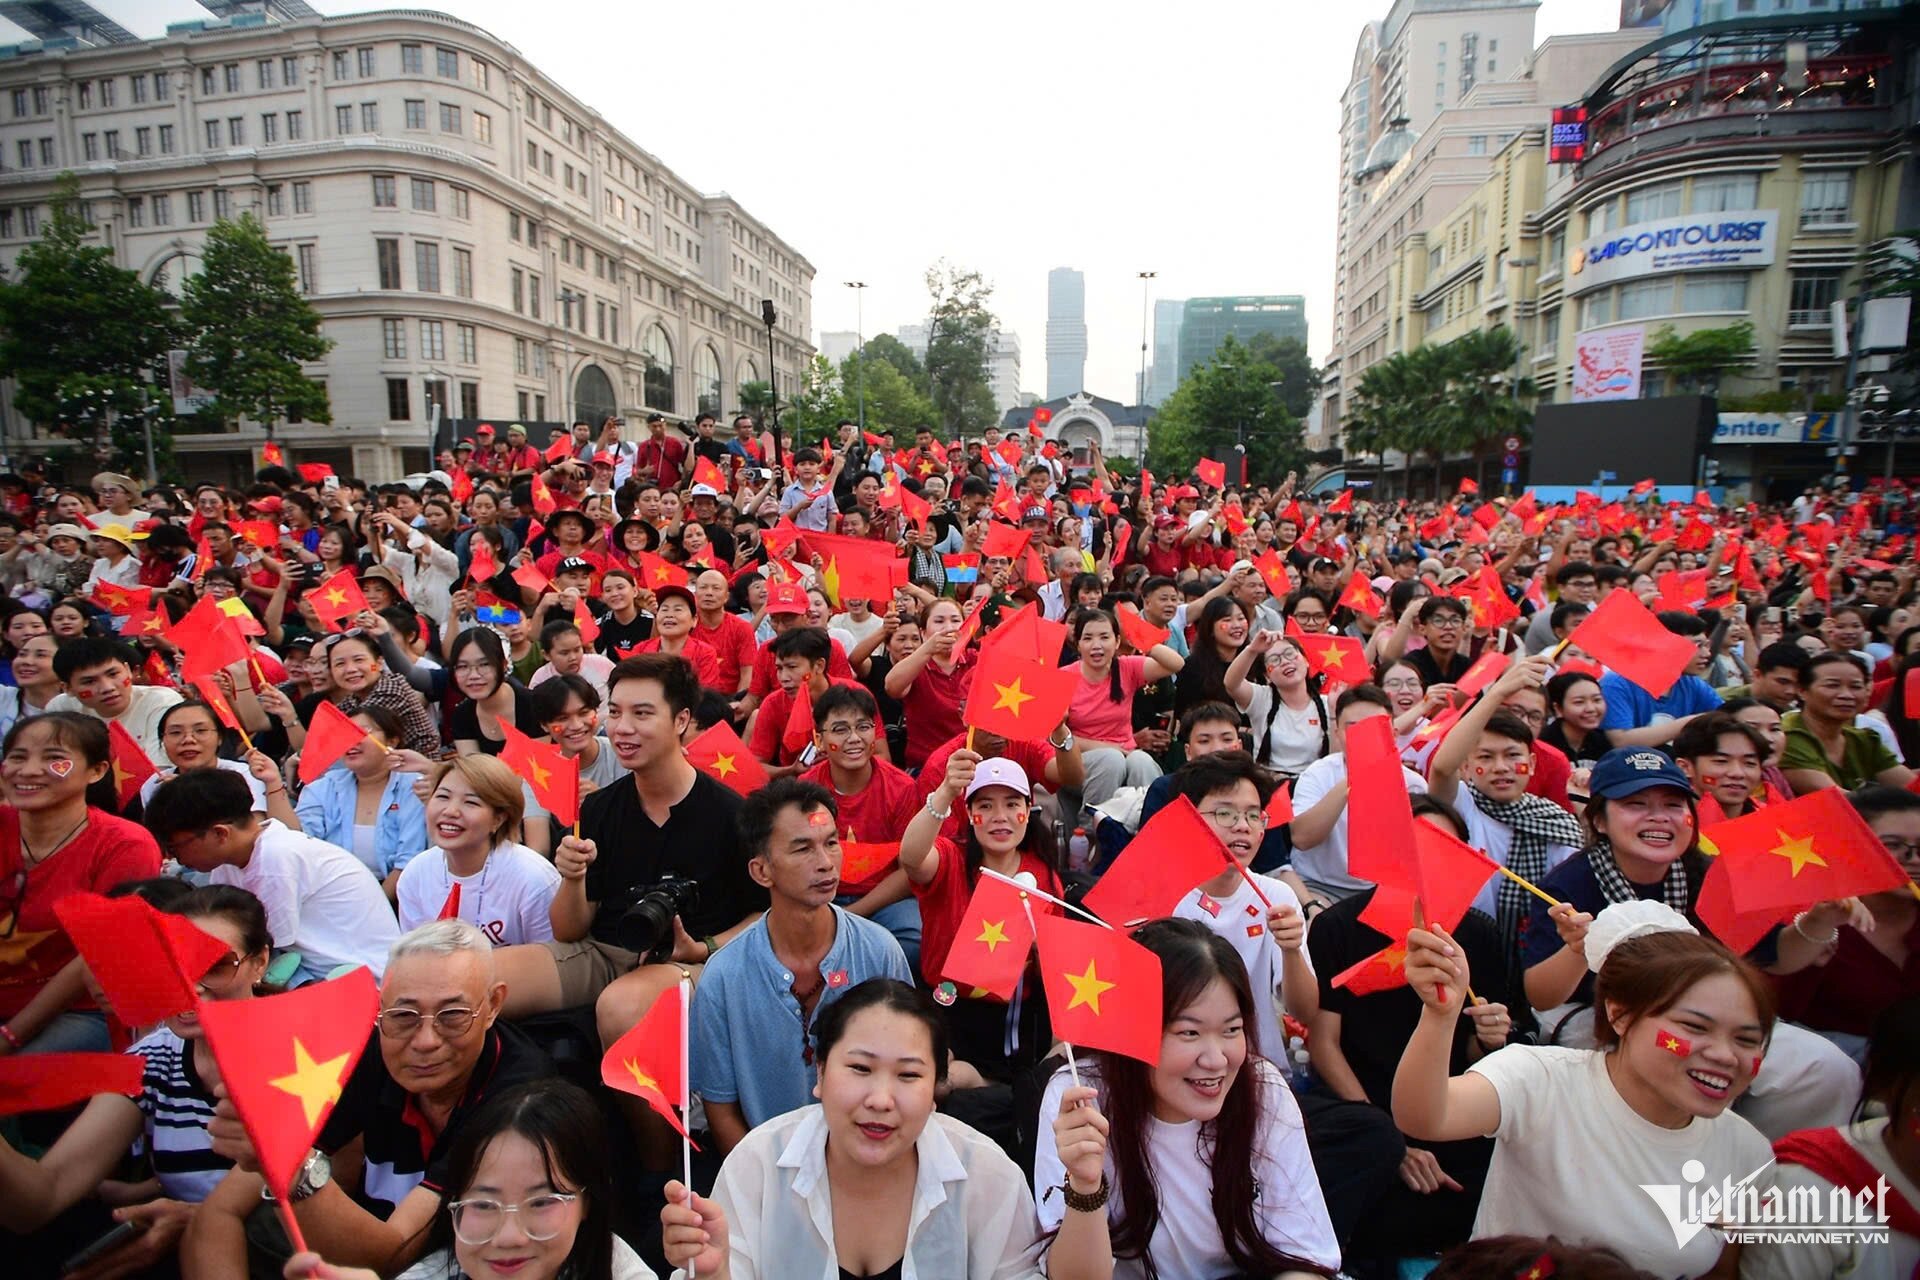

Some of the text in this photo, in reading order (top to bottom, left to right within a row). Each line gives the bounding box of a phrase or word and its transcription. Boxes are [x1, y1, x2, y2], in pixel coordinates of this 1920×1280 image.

[1552, 123, 1583, 134] SKY
[1552, 133, 1584, 143] ZONE
[1588, 221, 1767, 265] SAIGONTOURIST
